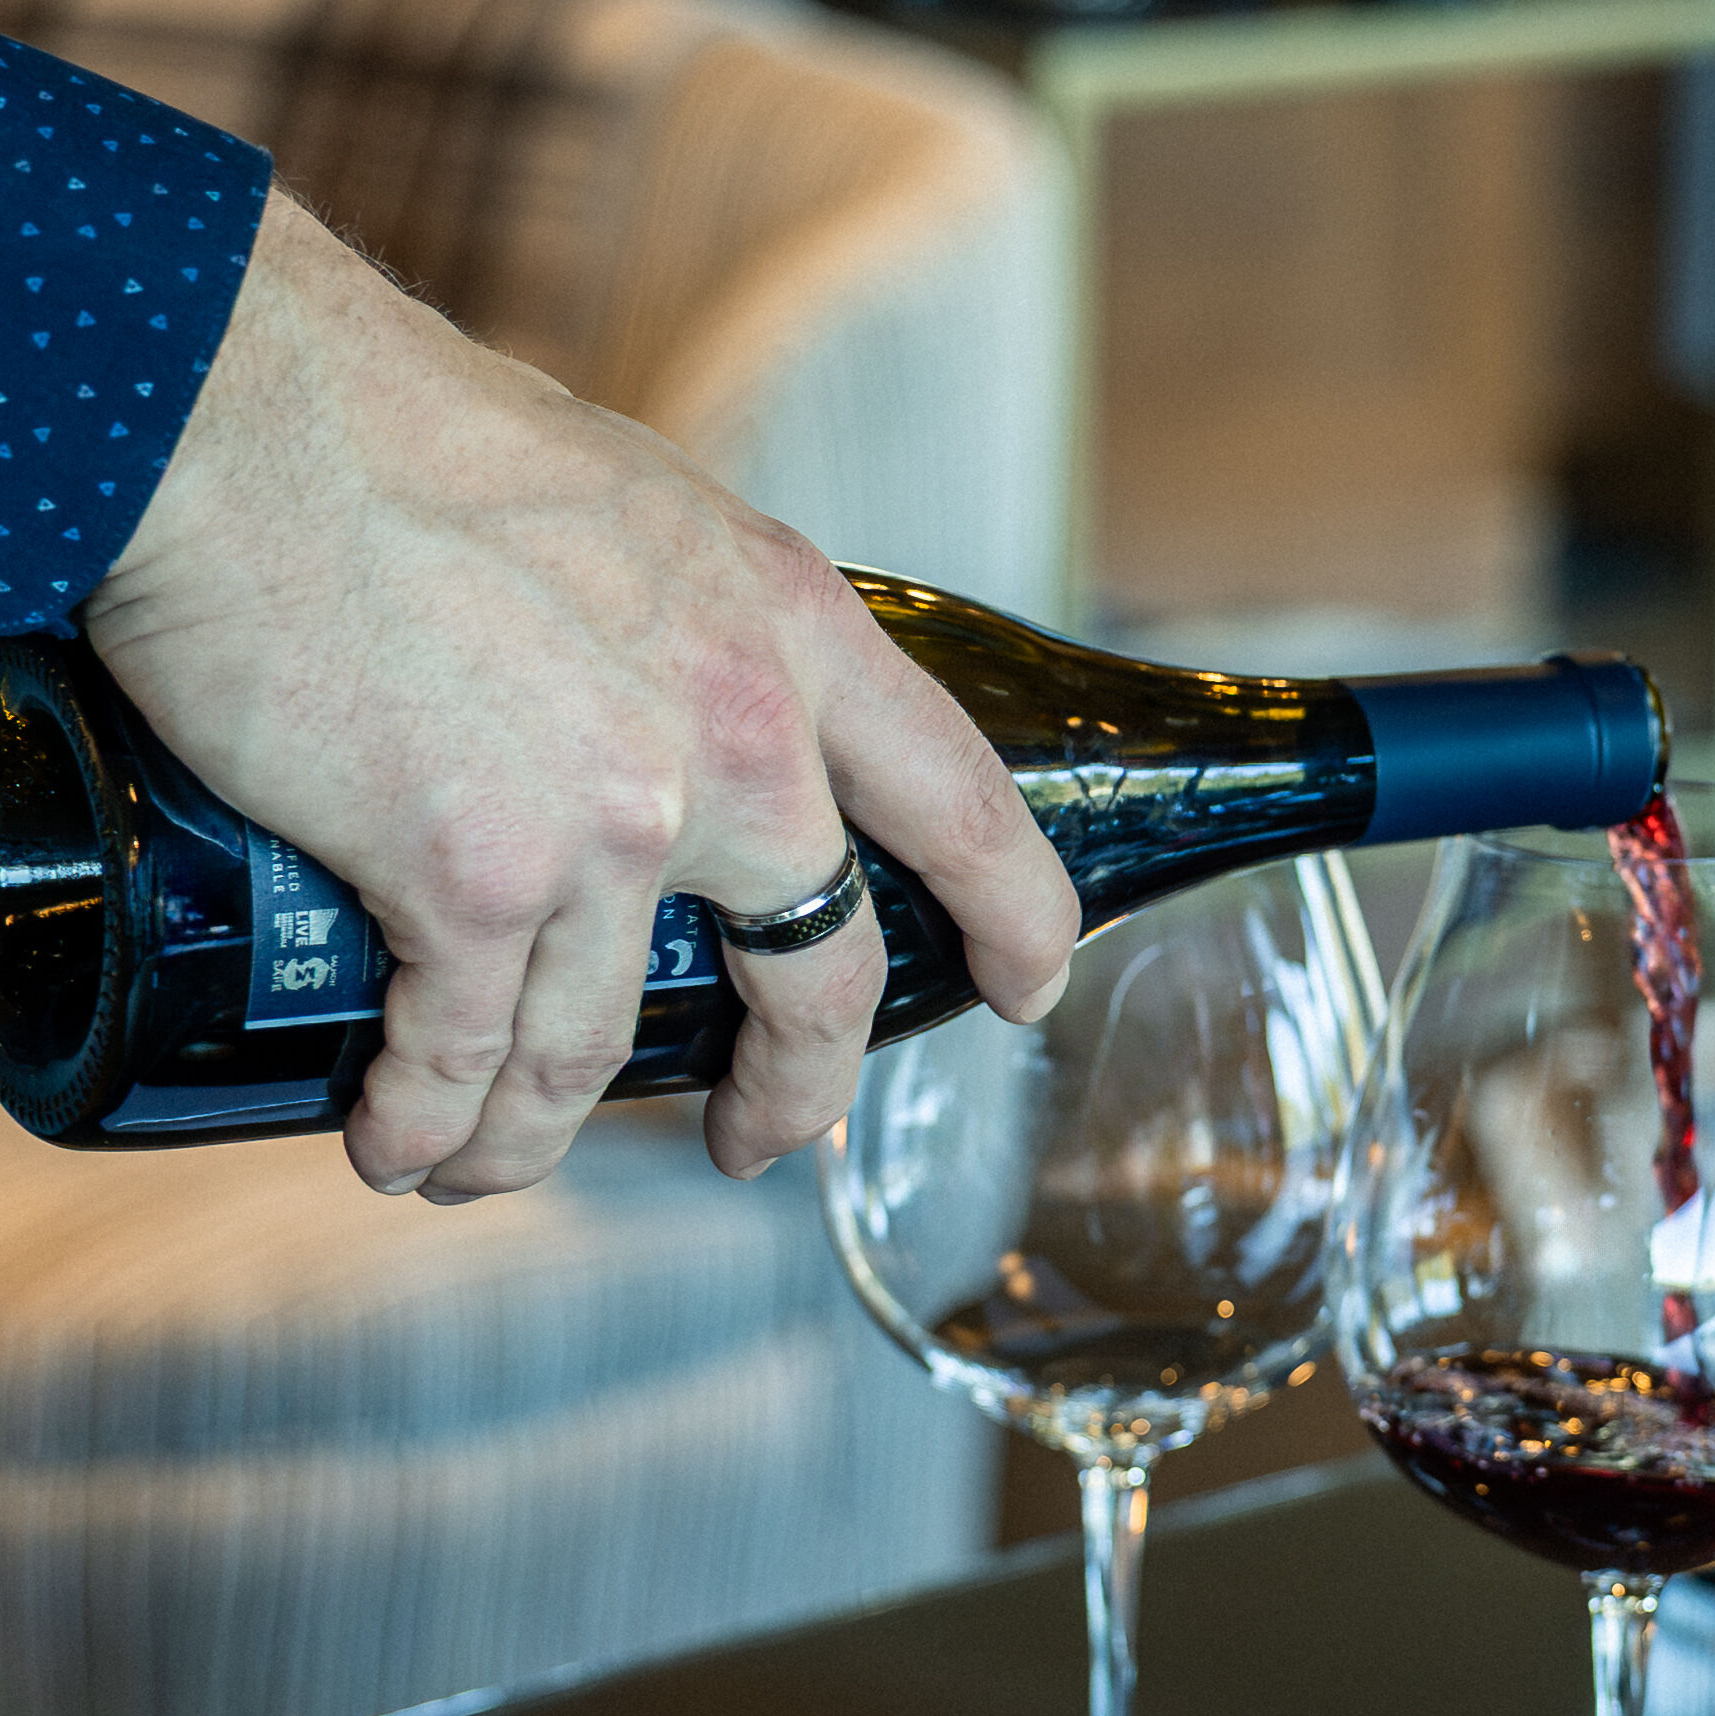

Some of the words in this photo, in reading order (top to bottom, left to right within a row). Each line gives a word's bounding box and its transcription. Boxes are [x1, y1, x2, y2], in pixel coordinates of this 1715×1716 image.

[269, 839, 286, 894] NABLE
[285, 847, 301, 892] IFIED
[295, 911, 309, 947] LIVE
